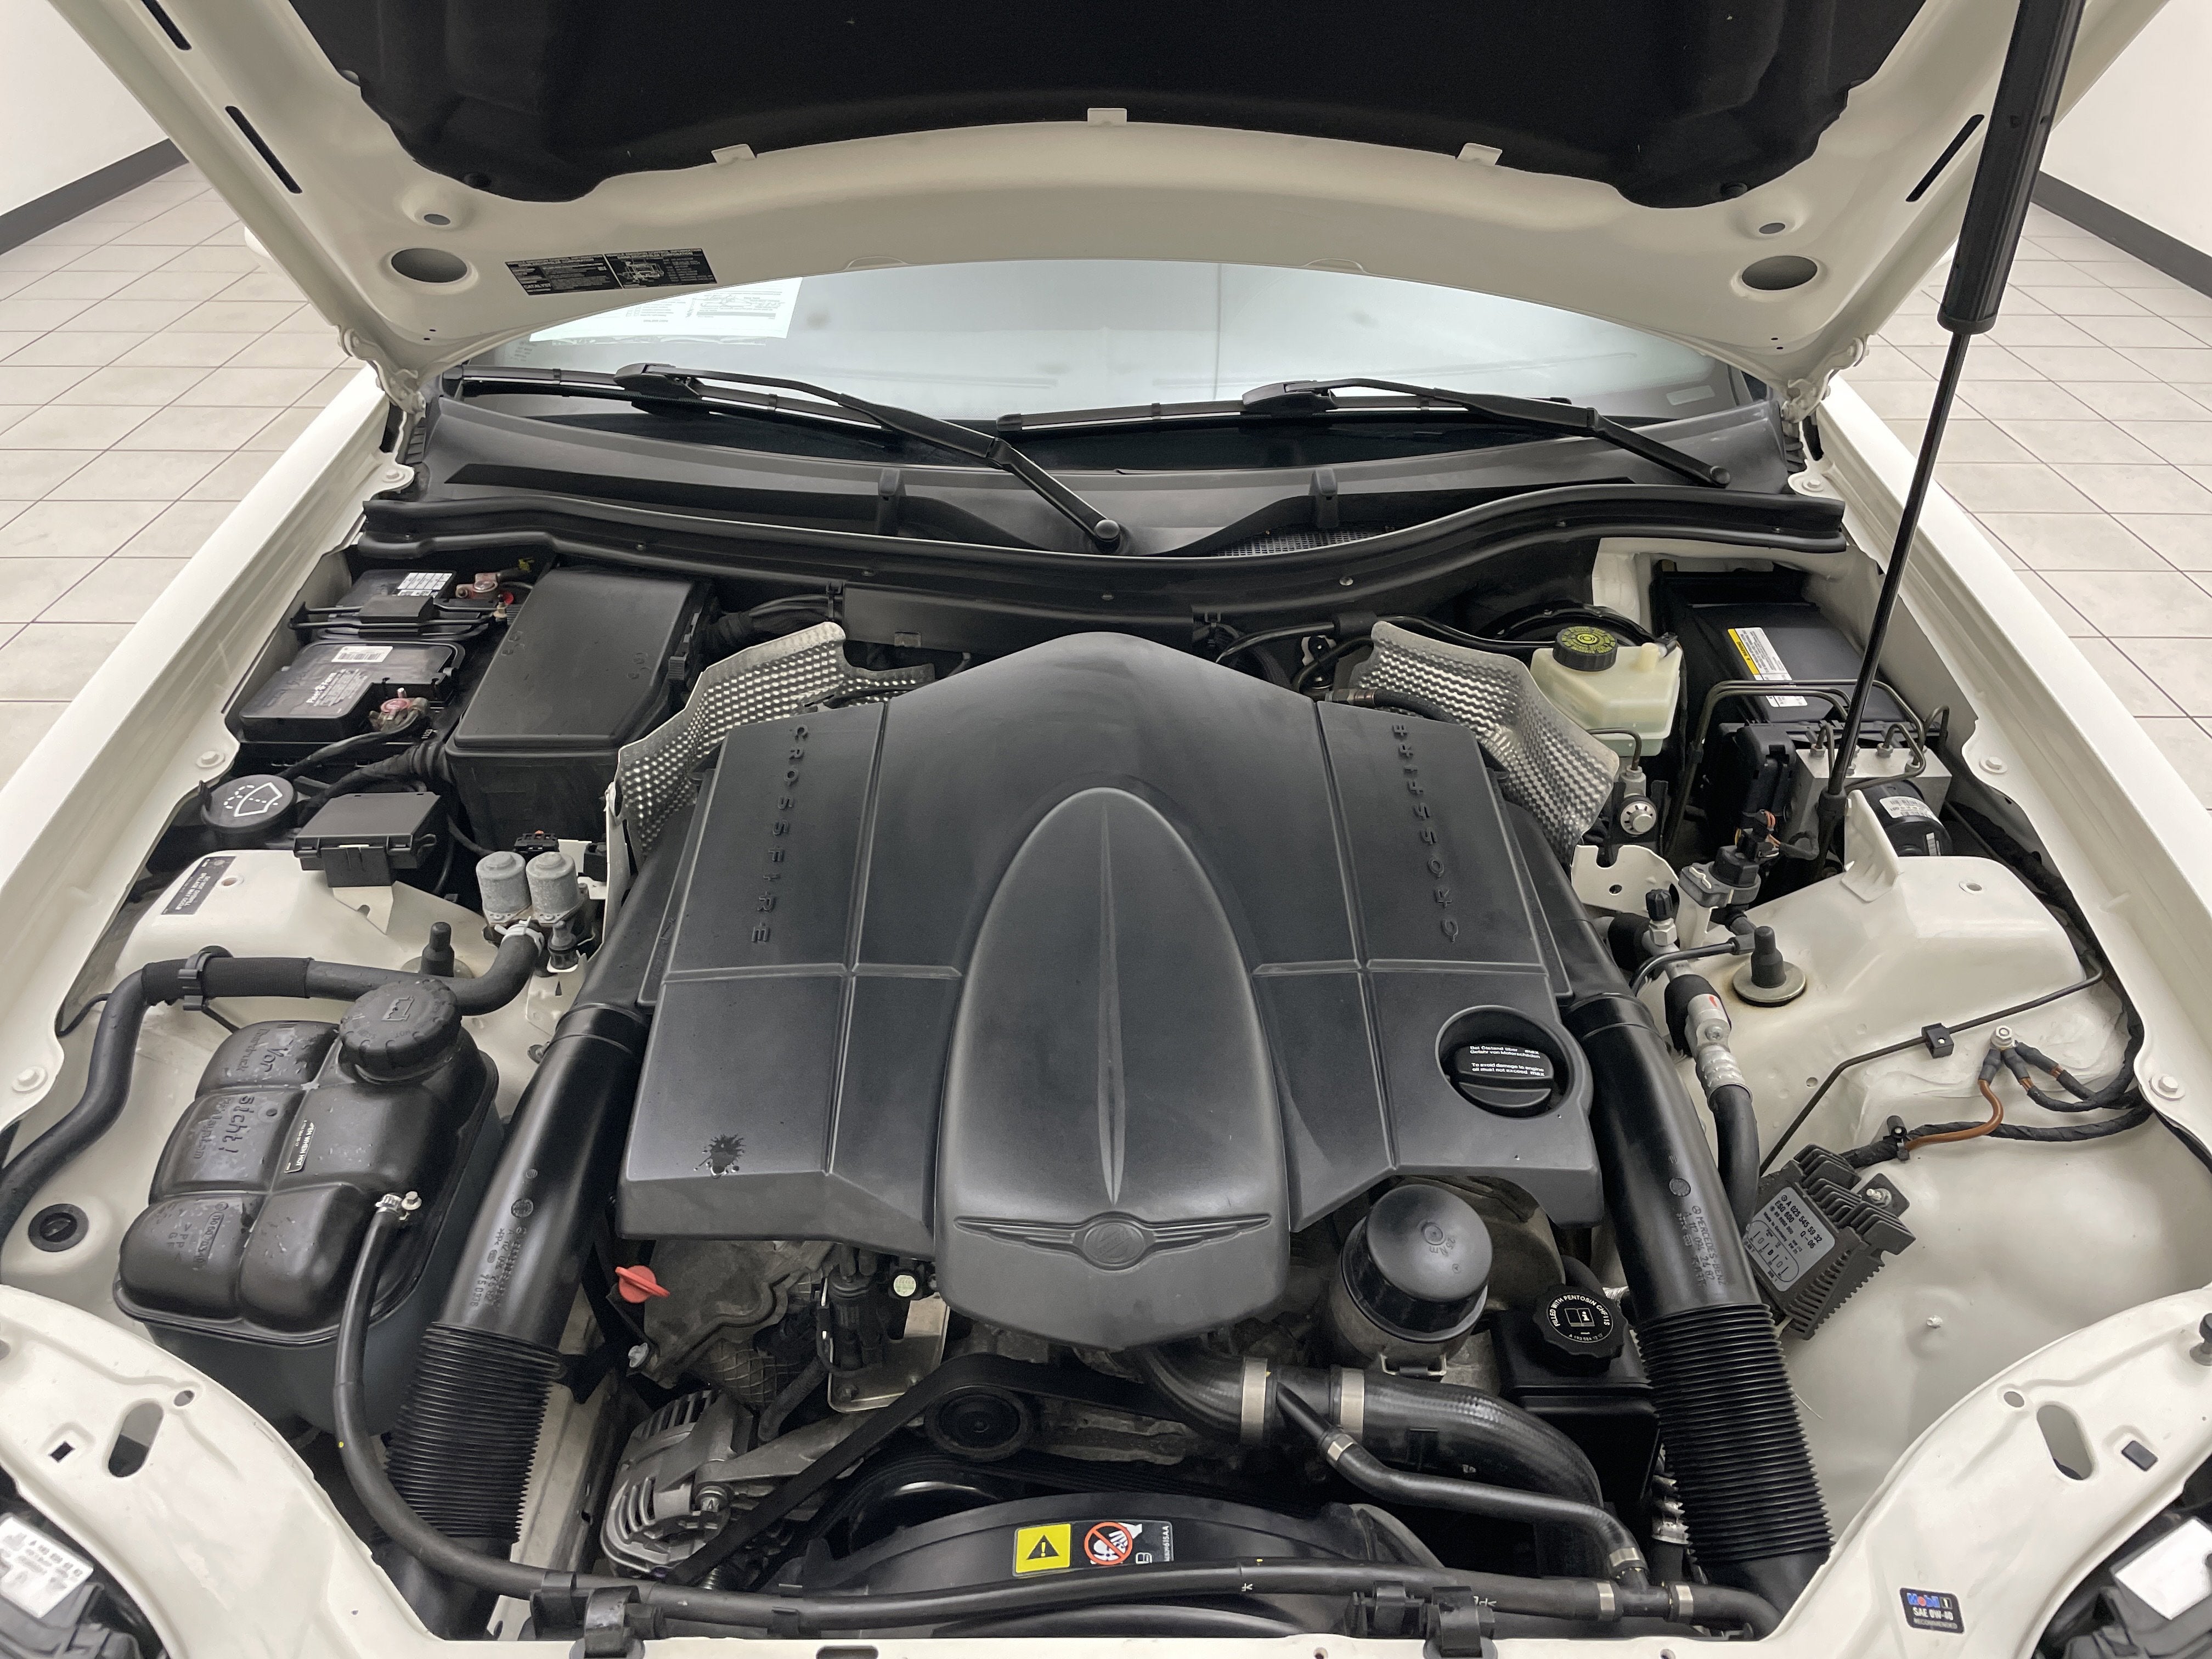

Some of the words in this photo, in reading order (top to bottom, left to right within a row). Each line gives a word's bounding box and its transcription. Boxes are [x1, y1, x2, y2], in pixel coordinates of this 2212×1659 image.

[752, 724, 809, 943] CROSSFIRE
[1392, 724, 1459, 943] CROSSFIRE
[300, 1135, 311, 1155] WHEN
[295, 1152, 306, 1167] HOT
[1784, 1211, 1795, 1223] 600
[1790, 1205, 1801, 1217] 025
[1798, 1215, 1810, 1228] 545
[1807, 1226, 1816, 1235] 59
[1814, 1234, 1822, 1243] 32
[1774, 1226, 1787, 1242] Germany
[1696, 1216, 1726, 1286] MERCEDES-BENZ
[1550, 1297, 1564, 1309] WITH
[1563, 1295, 1597, 1306] PENTOSIN
[1550, 1308, 1561, 1327] FILLED
[1596, 1305, 1611, 1326] CHF11S
[1906, 1593, 1940, 1608] Mobil
[1912, 1607, 1928, 1618] SAE
[1928, 1609, 1954, 1621] 0W-40
[1913, 1618, 1958, 1629] RECOMMENDED
